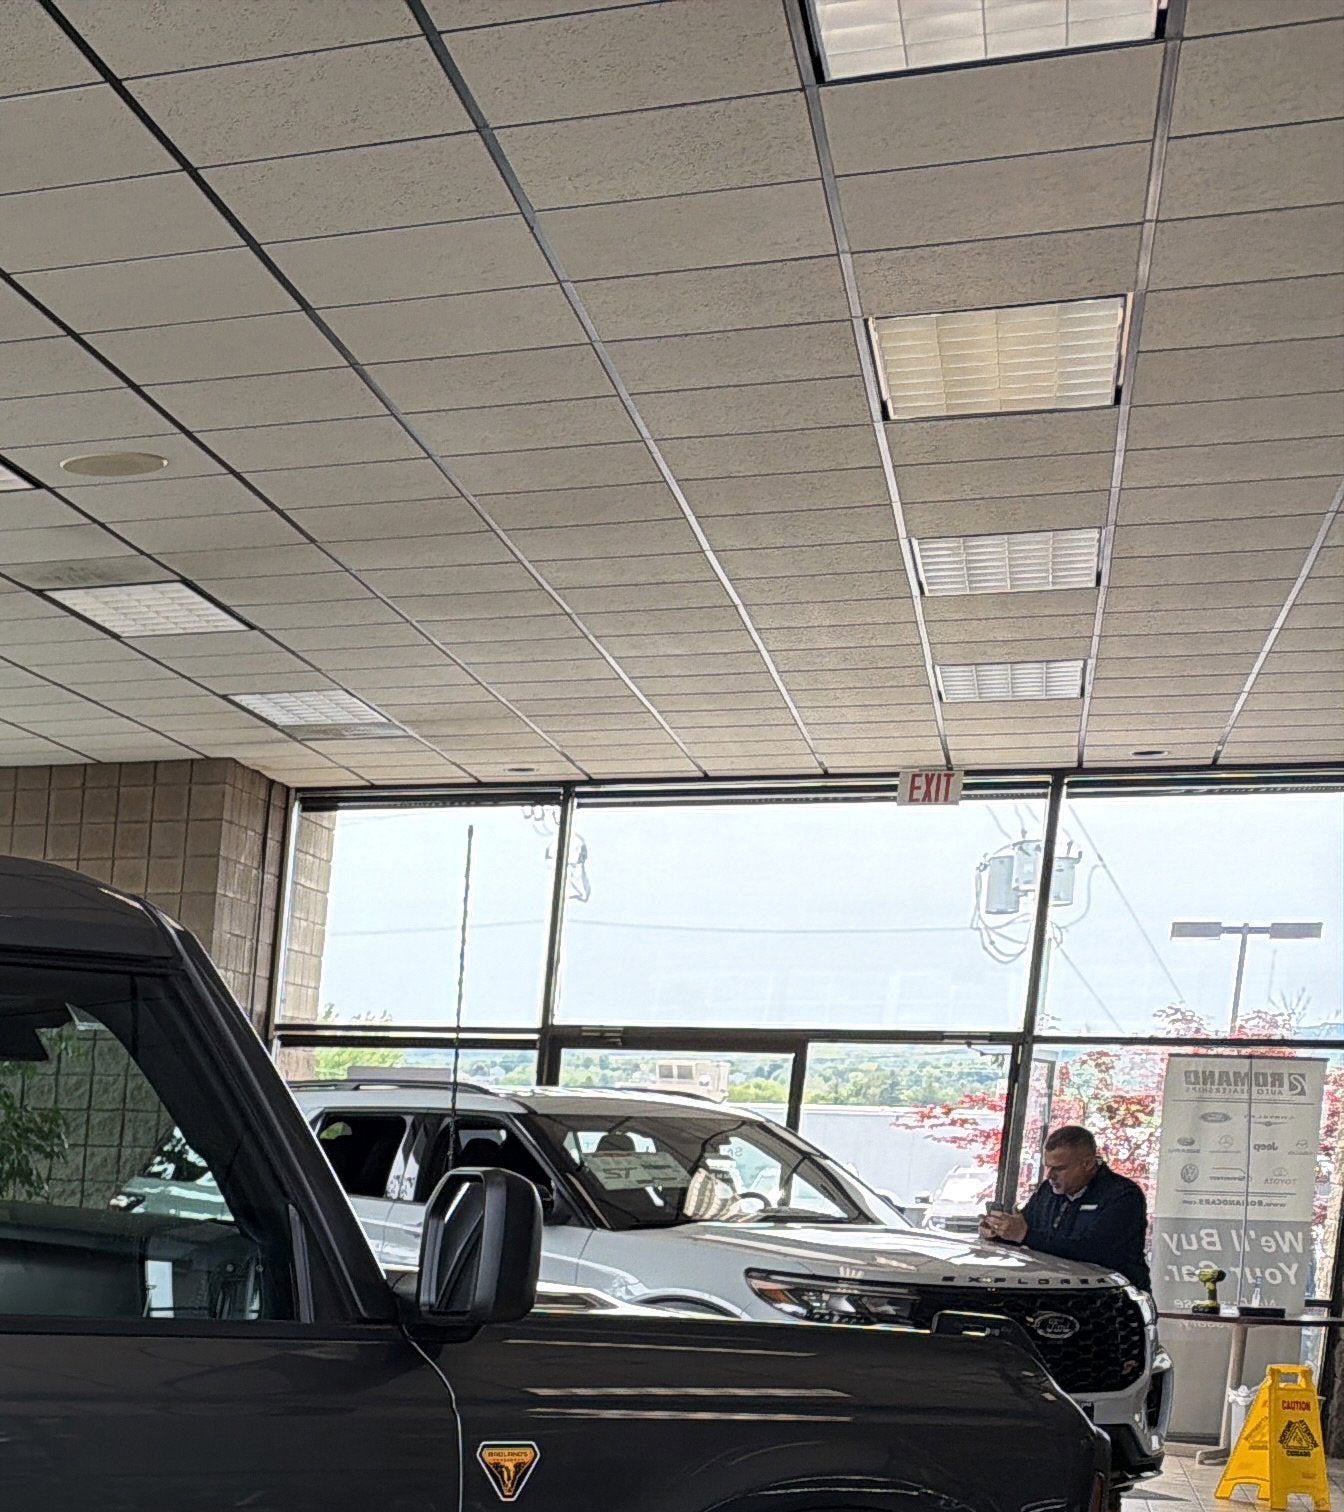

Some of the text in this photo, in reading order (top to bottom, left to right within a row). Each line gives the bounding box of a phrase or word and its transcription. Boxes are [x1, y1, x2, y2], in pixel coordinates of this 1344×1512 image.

[908, 773, 955, 803] EXIT
[941, 1275, 1109, 1285] EXPLORER
[1282, 1400, 1311, 1411] CAUTION
